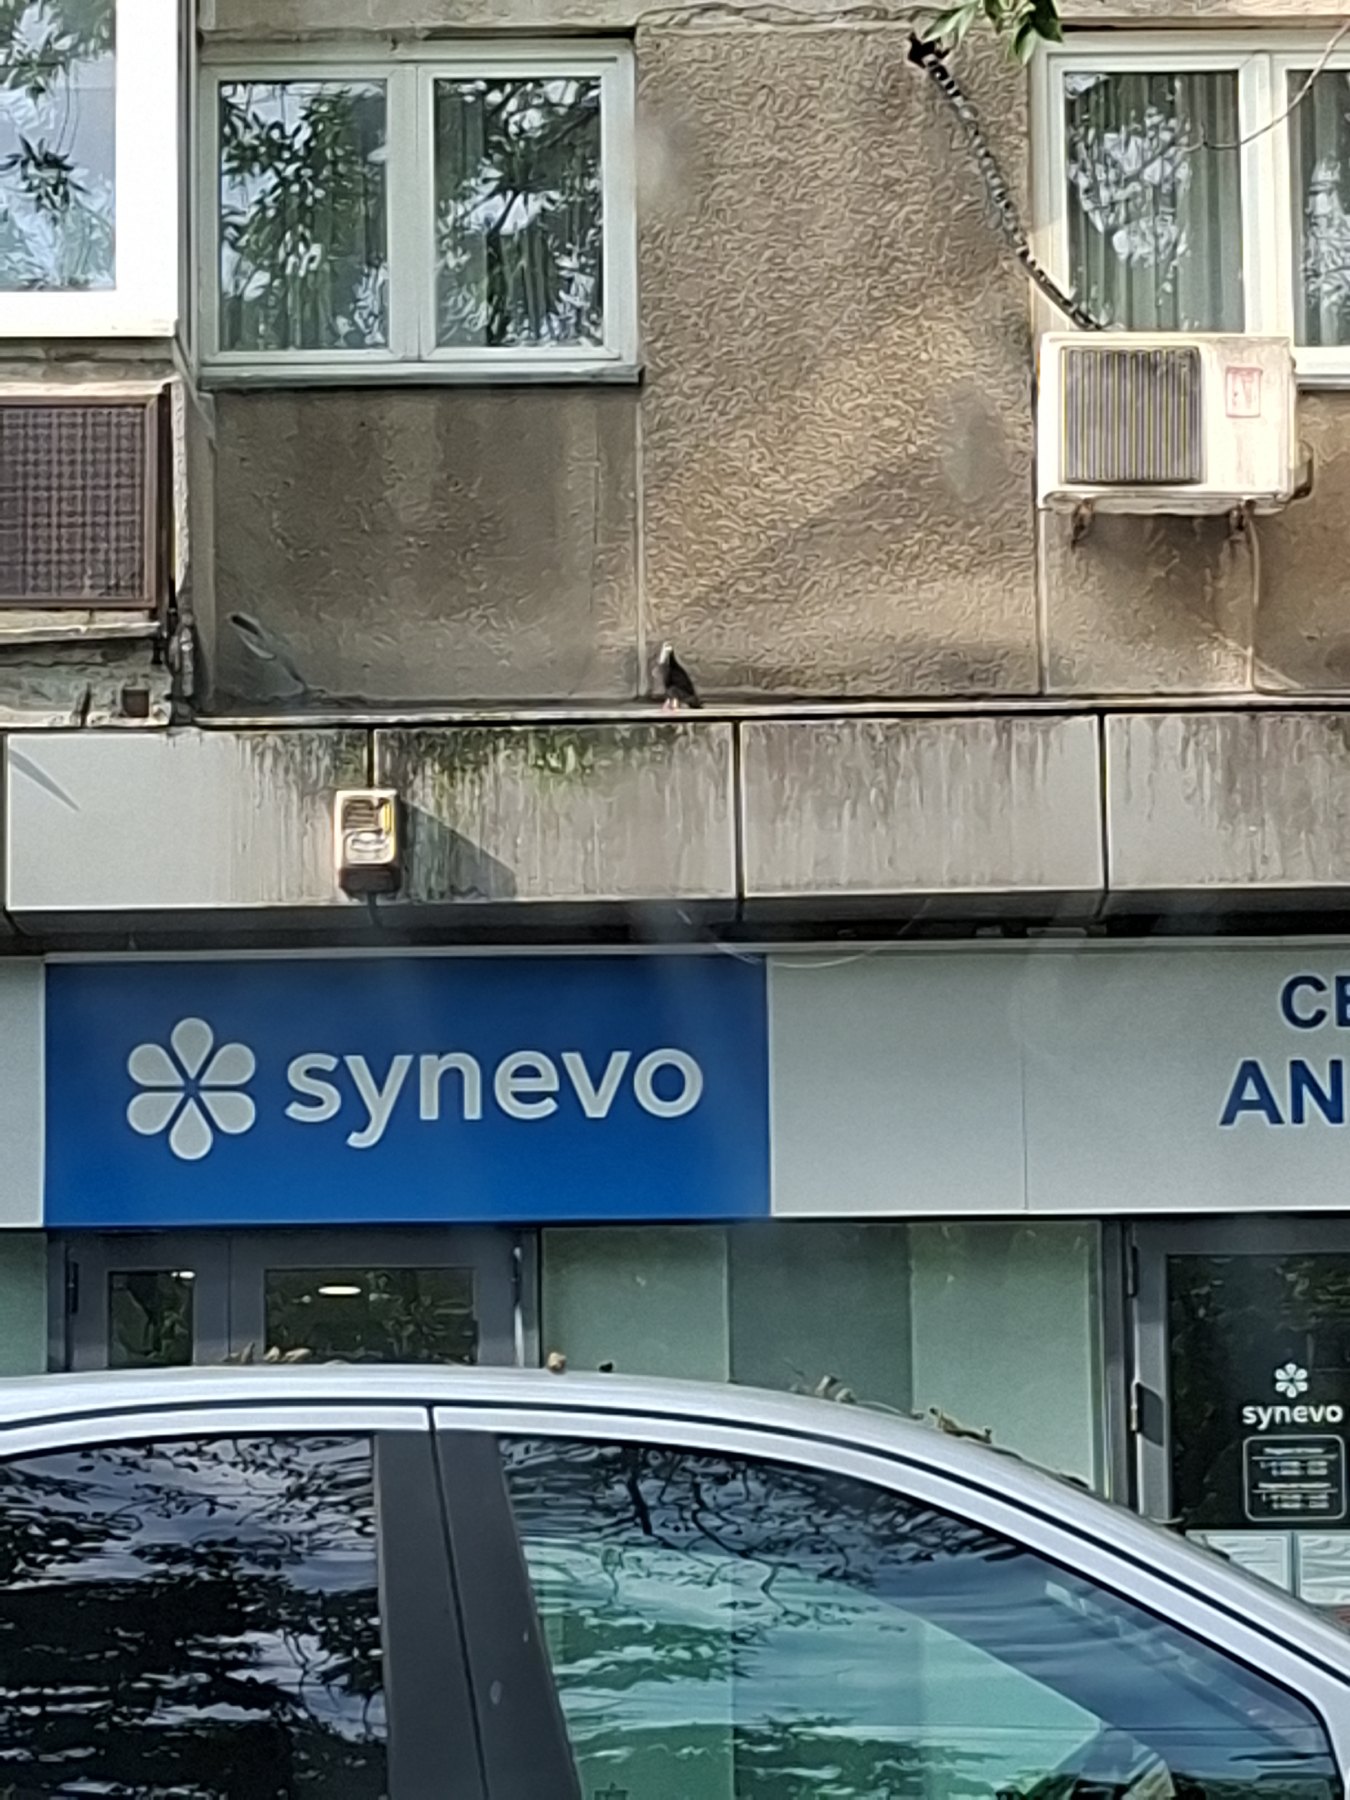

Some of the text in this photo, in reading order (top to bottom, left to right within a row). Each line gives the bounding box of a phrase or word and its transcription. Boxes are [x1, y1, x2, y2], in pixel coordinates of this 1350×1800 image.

[285, 1048, 703, 1149] synevo
[1219, 1059, 1344, 1126] AN
[1242, 1404, 1343, 1430] synevo
